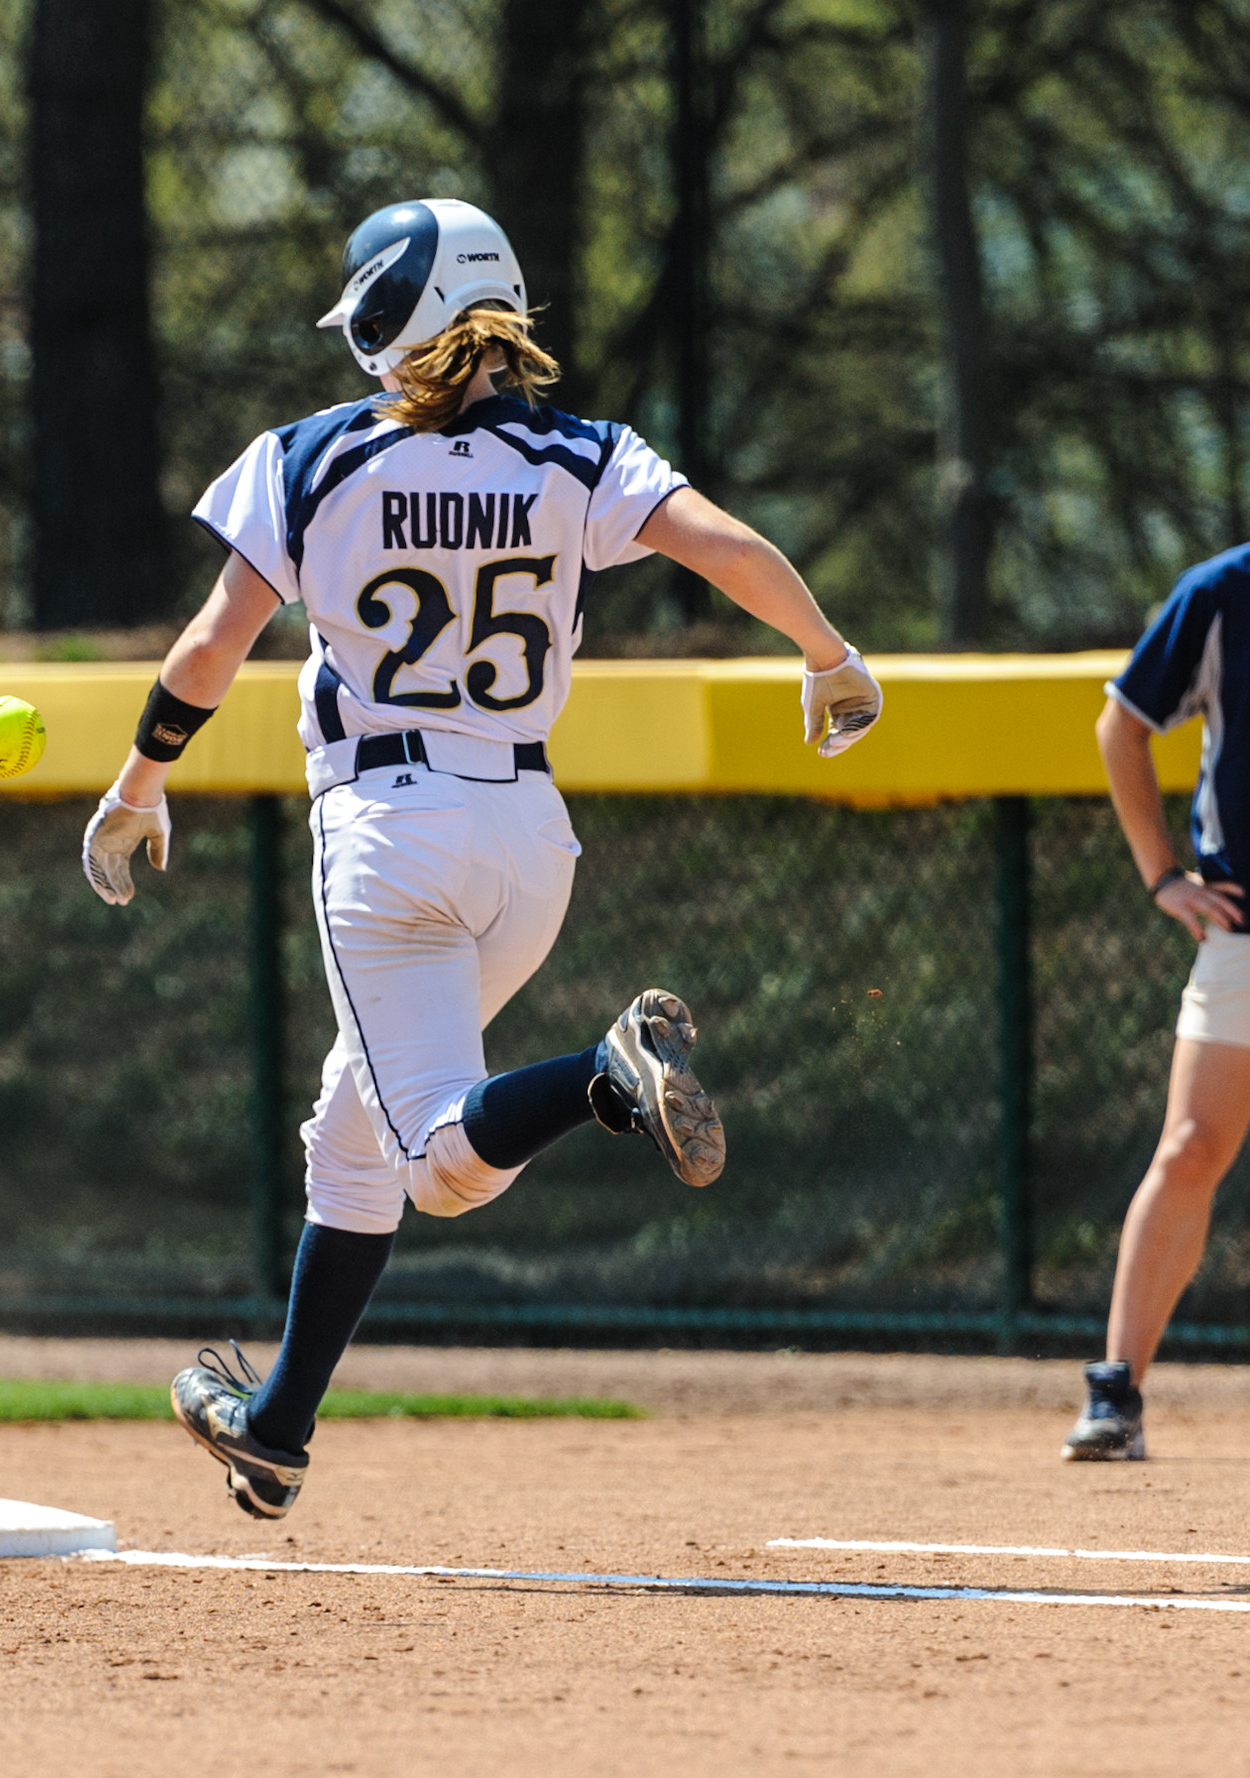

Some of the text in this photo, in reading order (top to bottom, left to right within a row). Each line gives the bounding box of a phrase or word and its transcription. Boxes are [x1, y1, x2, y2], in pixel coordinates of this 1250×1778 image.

[467, 253, 500, 262] WORTH
[382, 491, 538, 550] RUDNIK
[356, 554, 558, 712] 25
